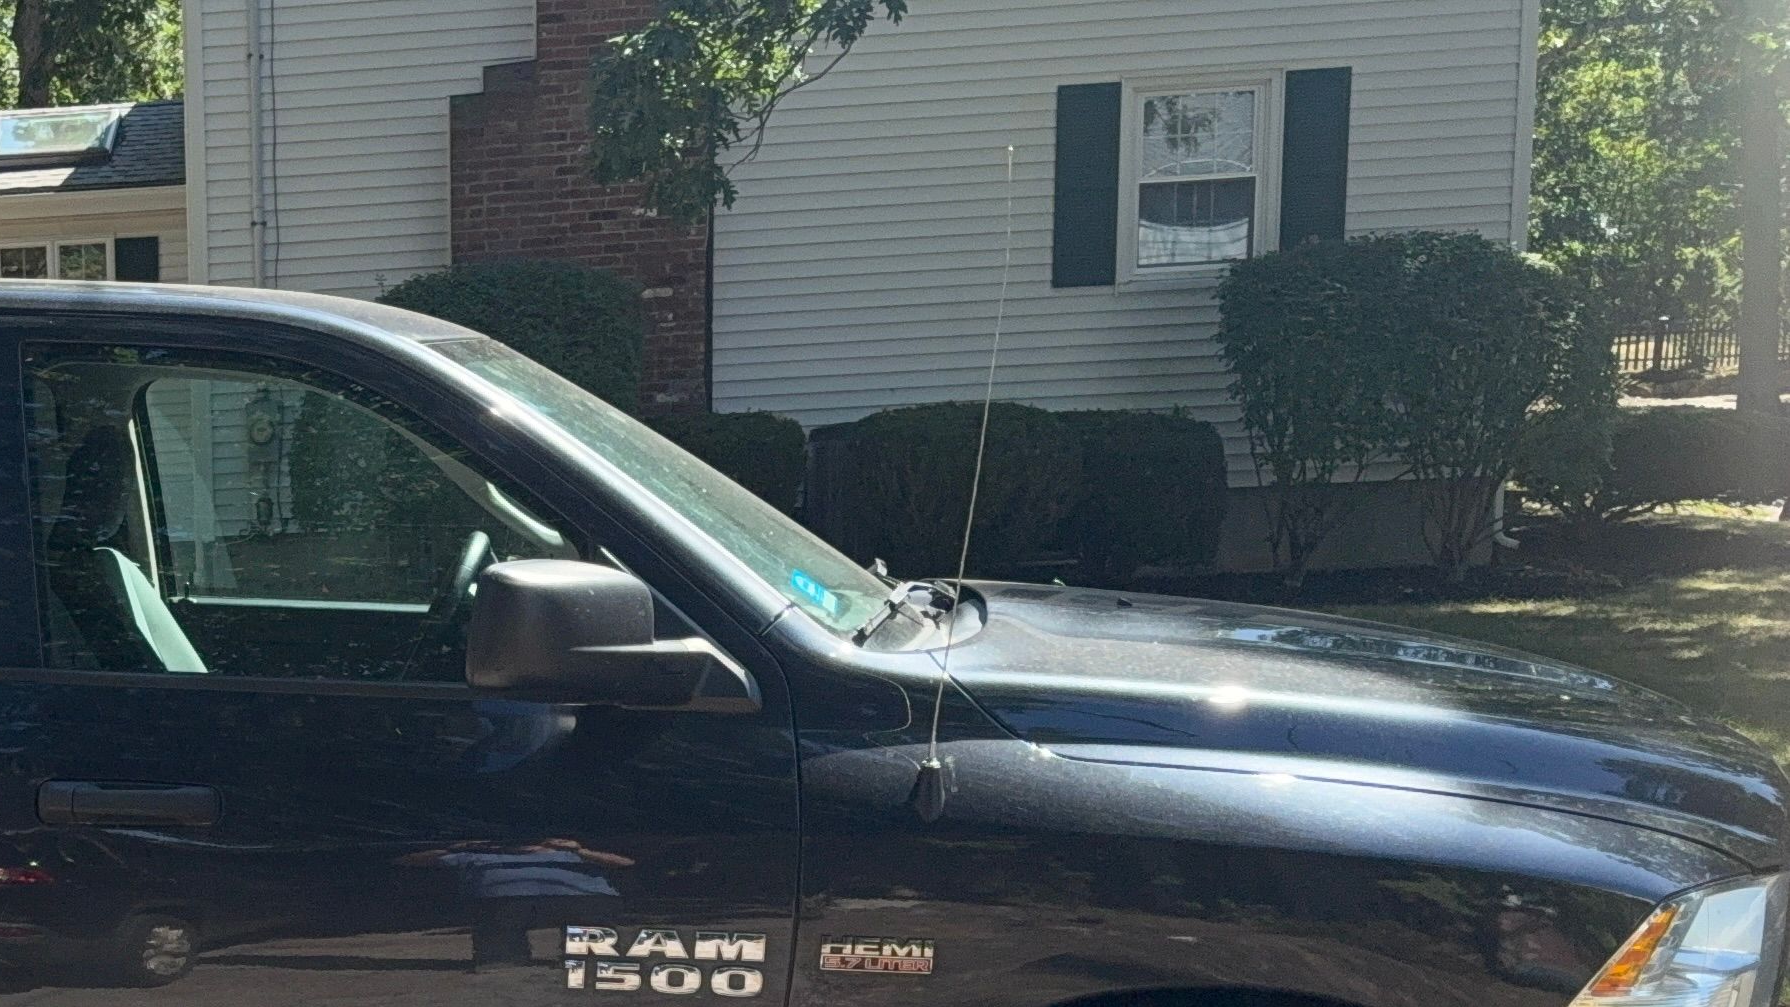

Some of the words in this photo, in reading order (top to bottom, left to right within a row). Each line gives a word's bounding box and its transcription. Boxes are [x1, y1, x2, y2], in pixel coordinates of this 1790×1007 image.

[565, 925, 767, 962] RAM
[821, 934, 935, 957] HEMI
[824, 956, 861, 969] 5.7
[865, 958, 929, 971] LITER
[565, 960, 764, 998] 1500
